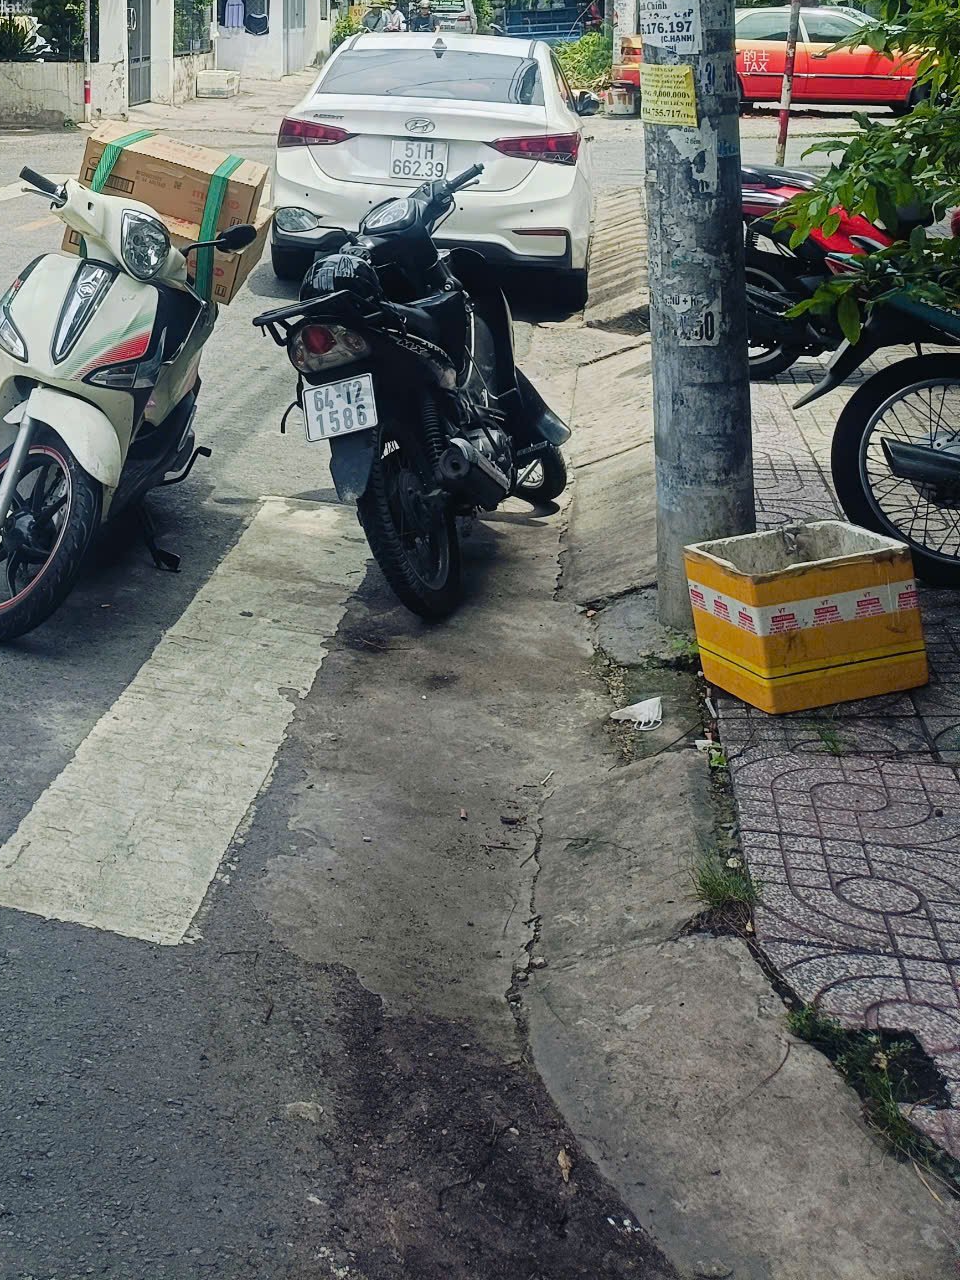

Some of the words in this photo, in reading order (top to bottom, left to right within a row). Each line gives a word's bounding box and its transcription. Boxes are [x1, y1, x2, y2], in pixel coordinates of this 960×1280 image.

[743, 49, 770, 62] 的士
[404, 142, 434, 159] 51H
[392, 159, 445, 178] 662.39
[313, 381, 364, 412] 64-T2
[316, 404, 368, 436] 1586
